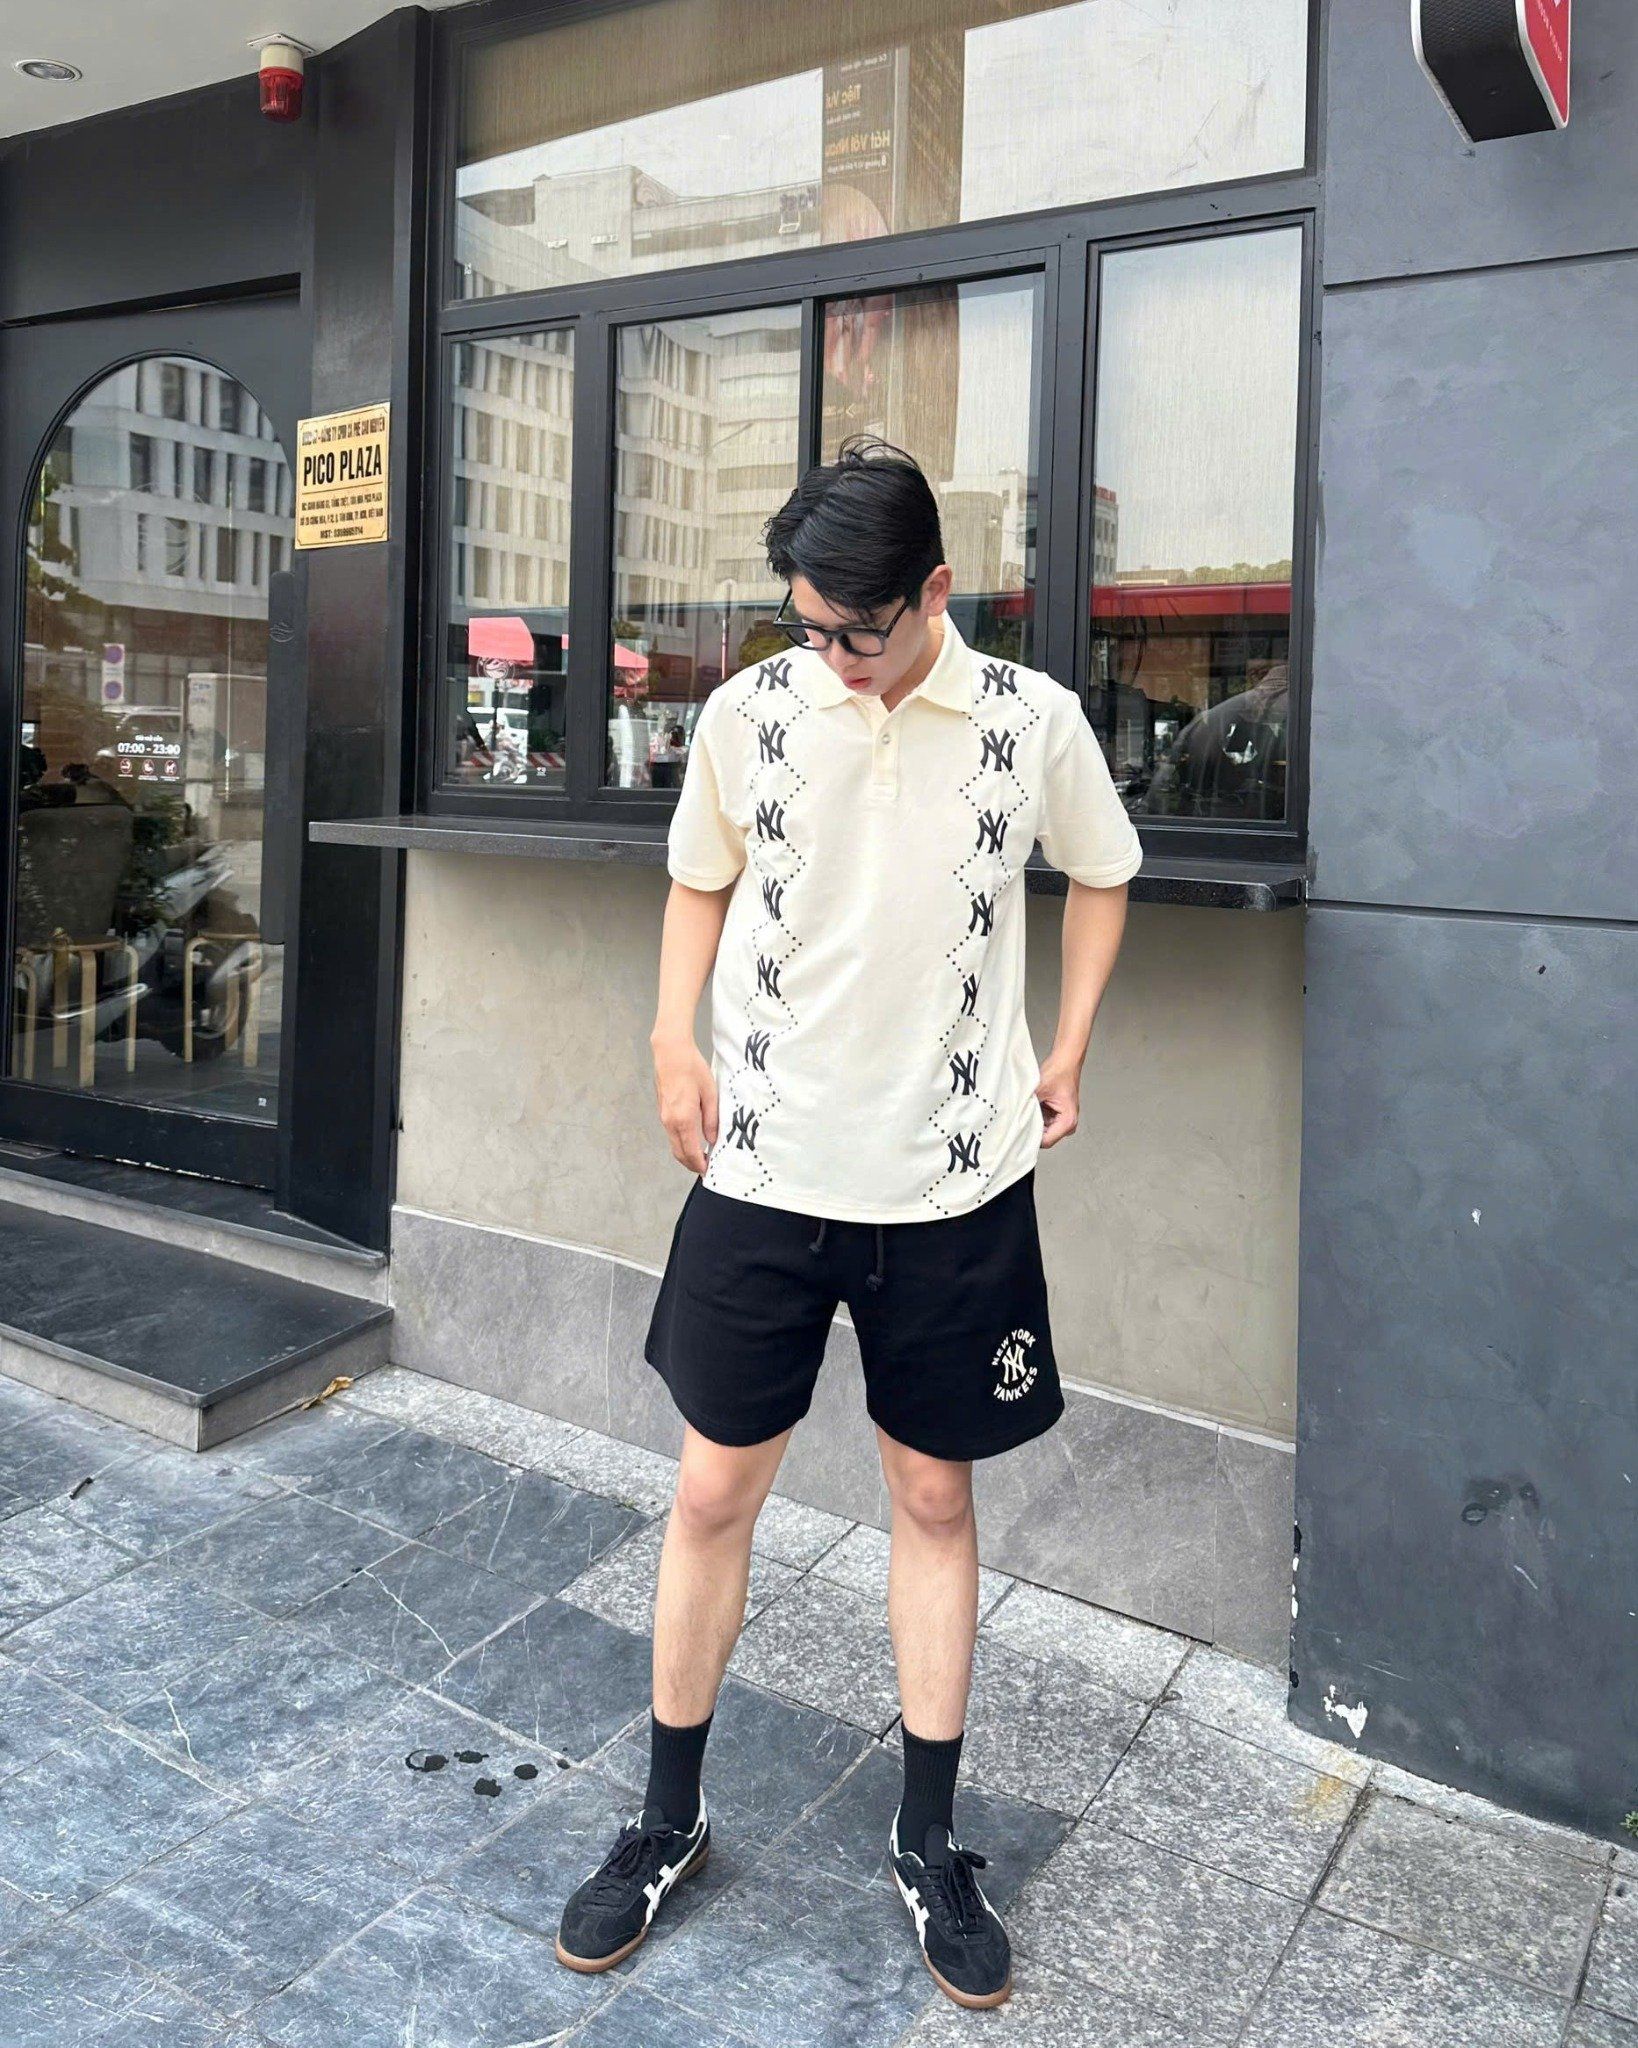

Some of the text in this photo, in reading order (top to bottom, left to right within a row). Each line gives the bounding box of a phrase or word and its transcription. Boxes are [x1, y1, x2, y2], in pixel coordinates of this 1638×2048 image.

[303, 444, 382, 486] PICO PLAZA
[756, 658, 792, 690] NY
[981, 663, 1017, 696] NY
[118, 742, 145, 754] 07:00
[152, 744, 181, 756] 23:00
[758, 720, 786, 764] NY
[980, 728, 1016, 772] NY
[756, 799, 785, 841] NY
[975, 809, 1008, 854] NY
[757, 954, 781, 999] NY
[744, 1030, 770, 1072] NY
[949, 1050, 979, 1096] NY
[726, 1105, 759, 1151] NY
[947, 1132, 981, 1174] NY
[991, 1328, 1036, 1366] NEW YORK
[1001, 1343, 1027, 1385] NY
[993, 1366, 1038, 1402] YANKEES
